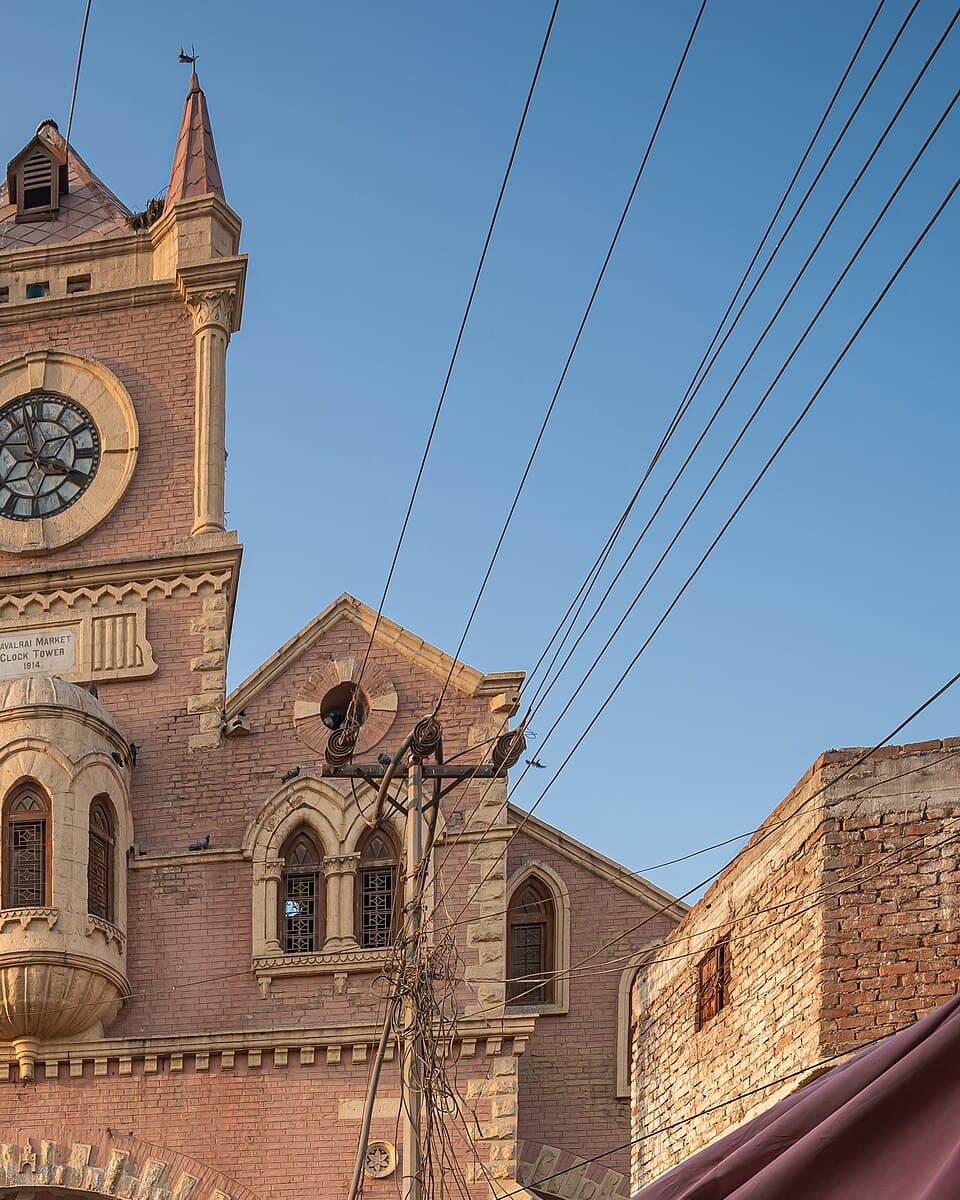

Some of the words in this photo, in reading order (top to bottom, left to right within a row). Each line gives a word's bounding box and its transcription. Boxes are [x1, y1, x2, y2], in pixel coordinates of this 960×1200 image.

[35, 635, 72, 647] MARKET
[0, 652, 29, 663] CLOCK
[33, 648, 65, 659] TOWER
[23, 661, 41, 670] 1914
